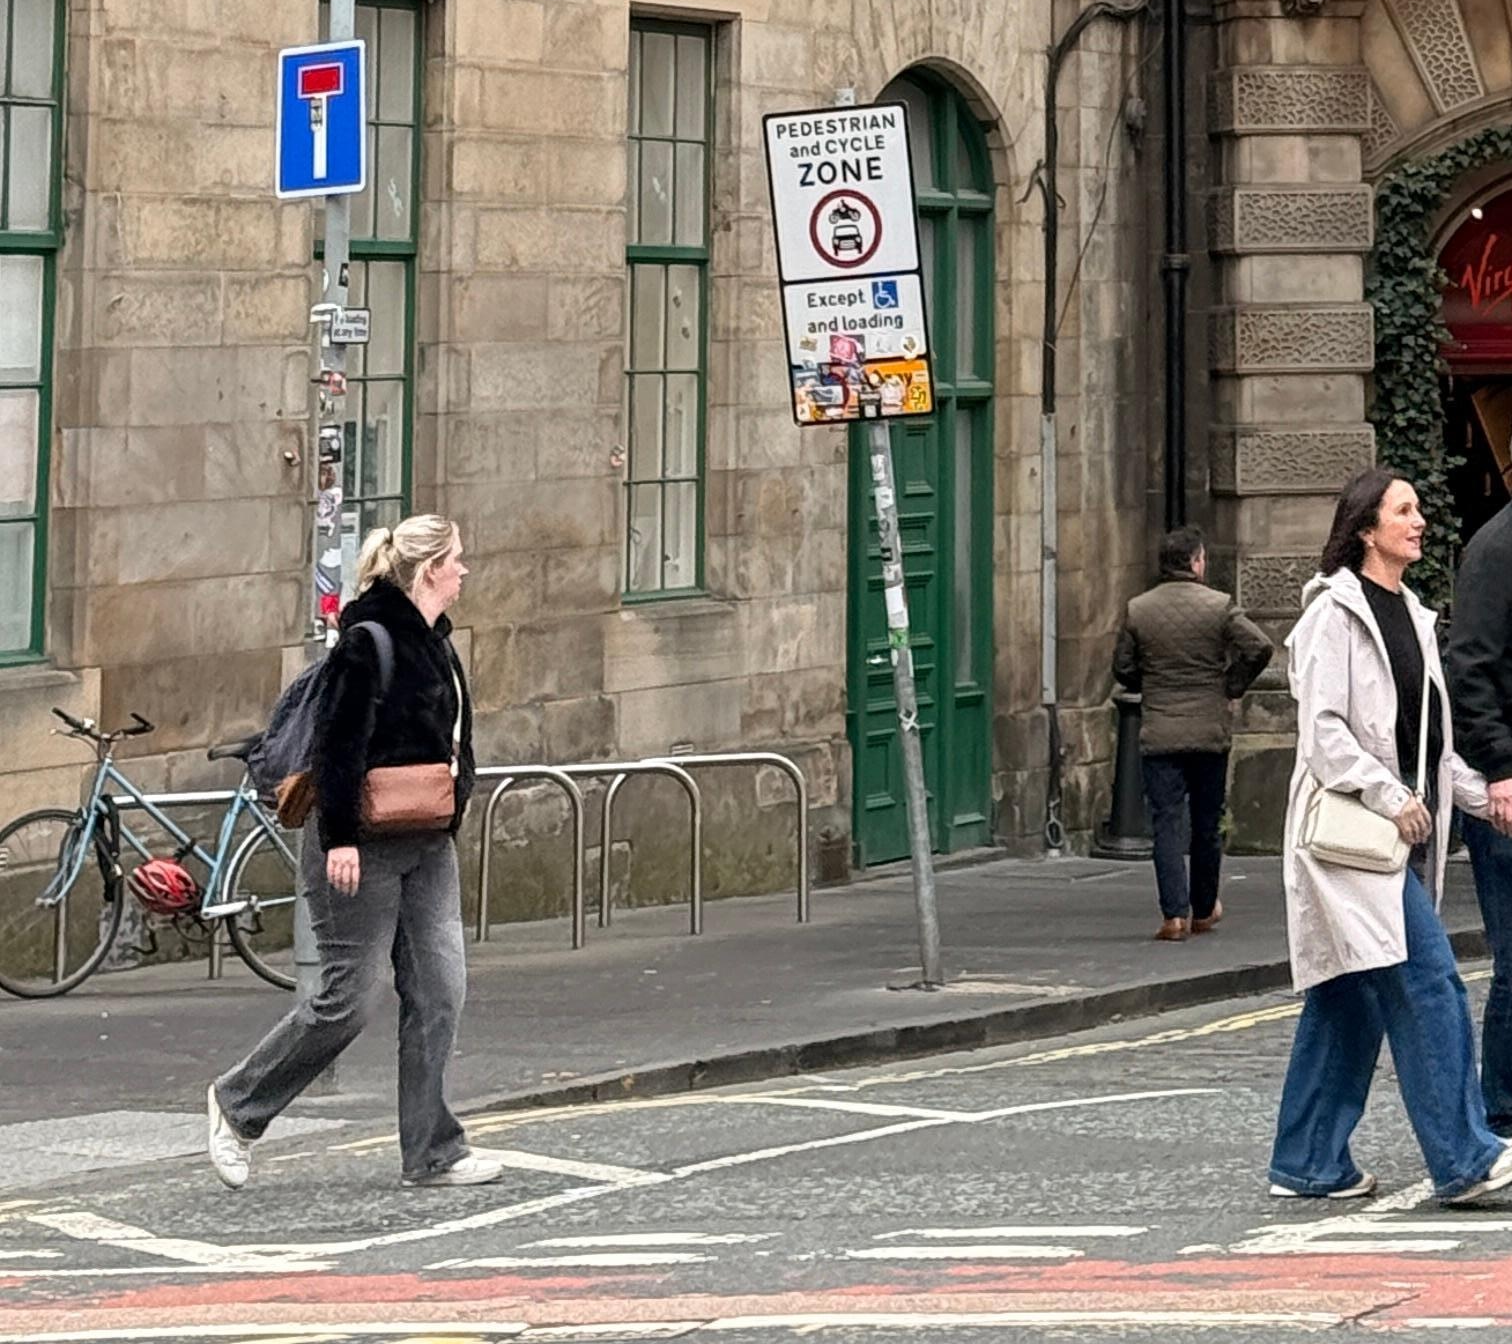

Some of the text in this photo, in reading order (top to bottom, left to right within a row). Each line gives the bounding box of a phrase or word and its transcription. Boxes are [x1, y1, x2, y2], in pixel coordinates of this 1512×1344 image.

[776, 113, 896, 139] PEDESTRIAN
[790, 135, 885, 158] and CYCLE
[798, 157, 883, 187] ZONE
[807, 288, 866, 308] Except
[808, 314, 903, 333] and loading
